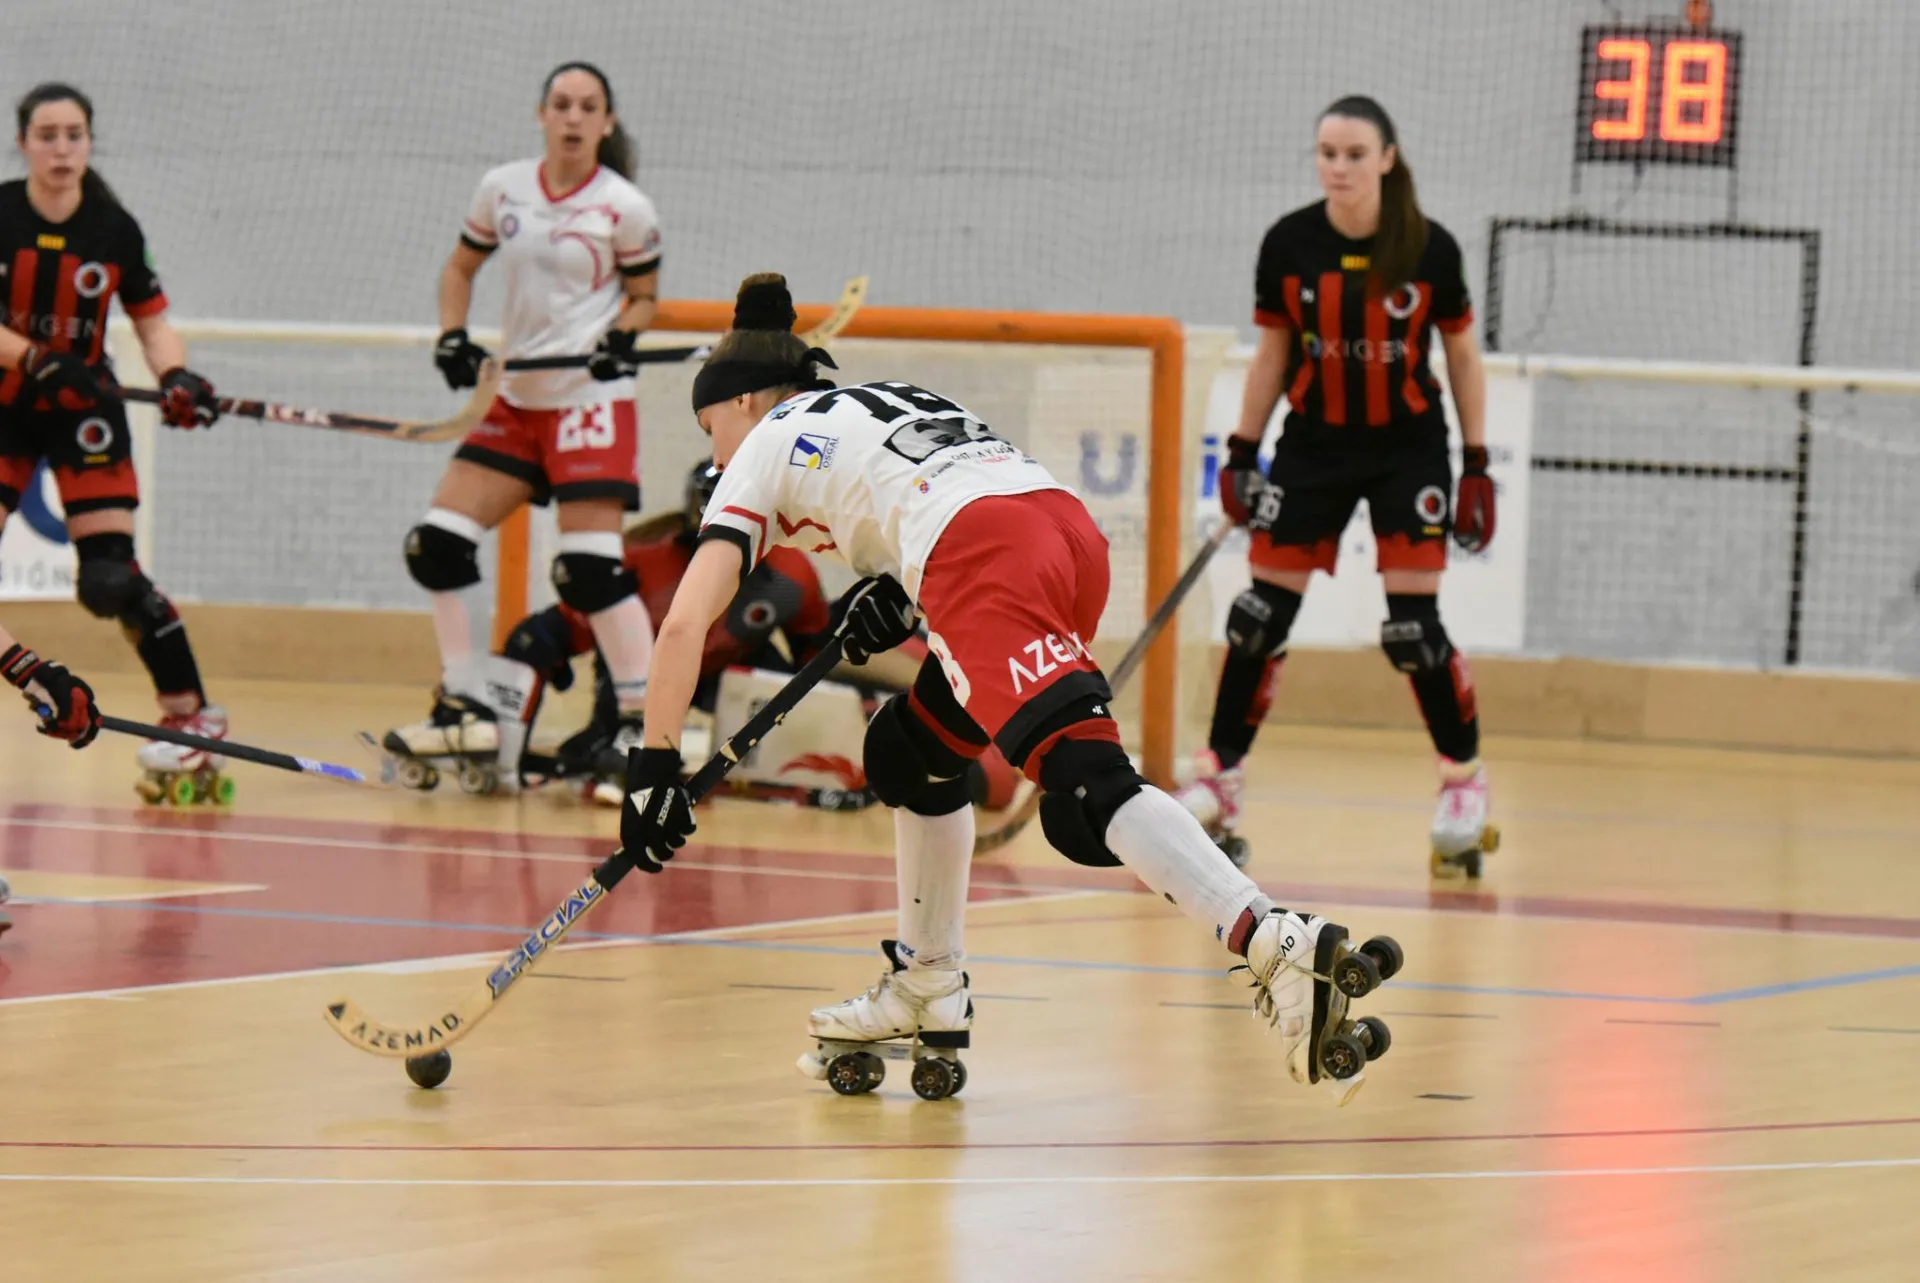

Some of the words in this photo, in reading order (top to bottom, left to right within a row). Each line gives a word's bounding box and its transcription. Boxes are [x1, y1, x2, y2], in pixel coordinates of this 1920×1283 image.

[1592, 39, 1726, 143] 38
[556, 400, 616, 452] 23
[488, 883, 602, 990] SPECIAL
